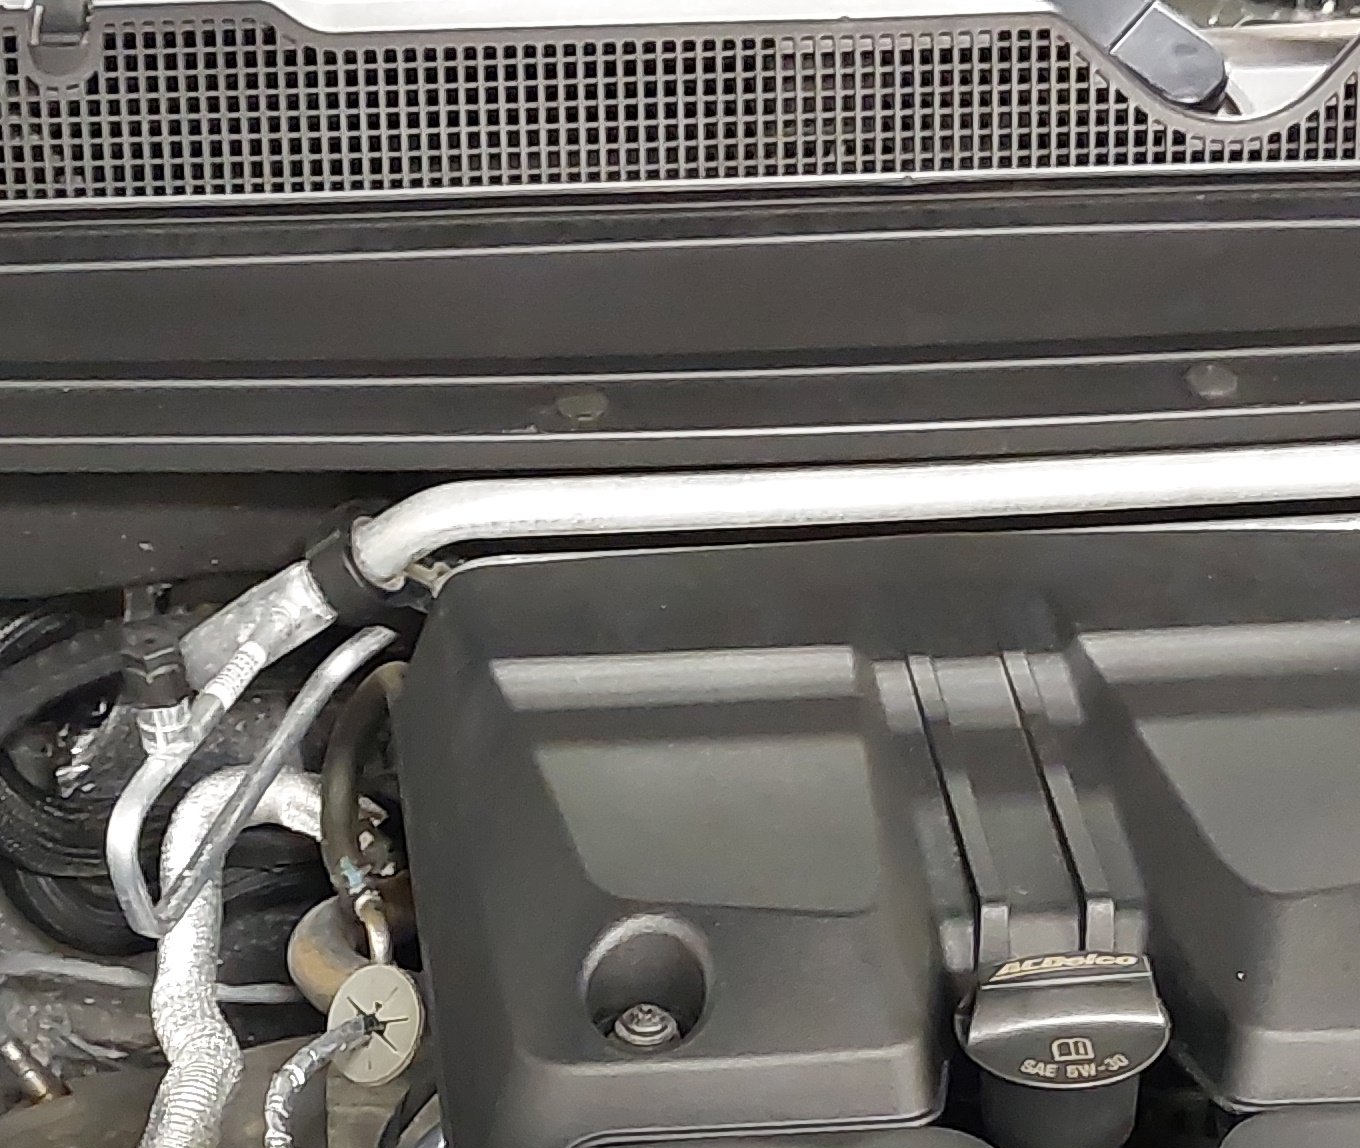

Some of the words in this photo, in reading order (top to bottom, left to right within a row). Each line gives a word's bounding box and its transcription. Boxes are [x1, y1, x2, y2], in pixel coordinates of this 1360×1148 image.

[994, 953, 1139, 977] ACDelco
[1020, 1059, 1059, 1078] SAE
[1065, 1053, 1130, 1078] 5W-30
